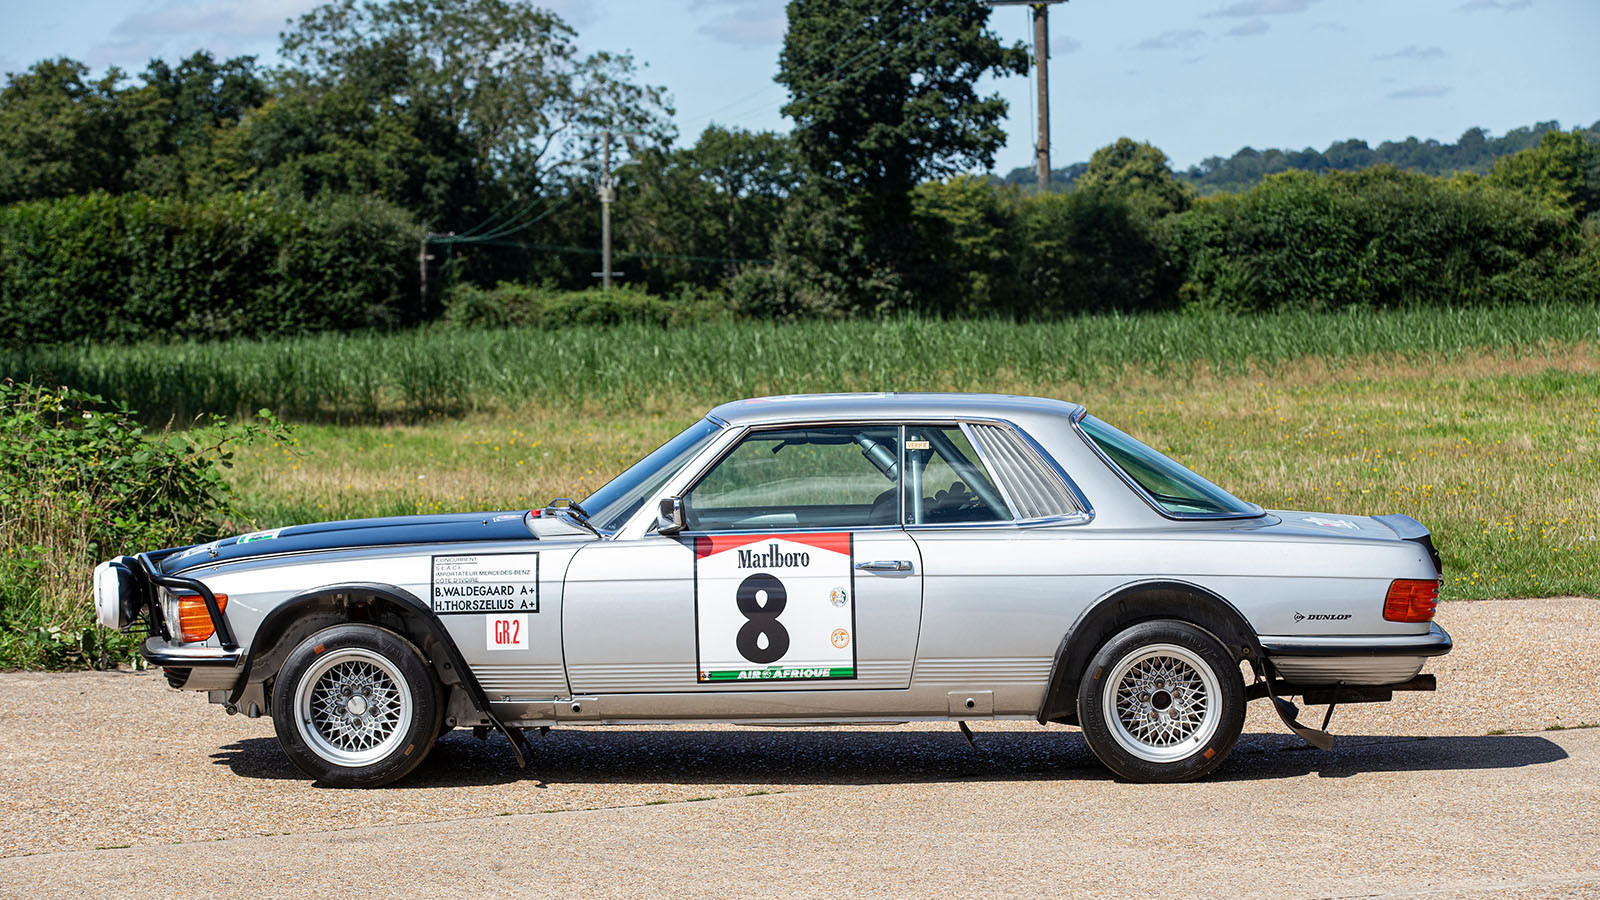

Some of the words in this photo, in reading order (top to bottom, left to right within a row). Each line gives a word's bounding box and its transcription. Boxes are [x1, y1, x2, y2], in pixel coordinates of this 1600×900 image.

[737, 543, 810, 569] Marlboro
[435, 585, 515, 597] B.WALDEGAARD
[520, 585, 535, 595] A+
[435, 599, 514, 611] H.THORSZELIUS
[520, 599, 535, 609] A+
[735, 572, 791, 665] 8
[494, 619, 520, 645] GR.2
[736, 670, 762, 679] AIR
[772, 668, 831, 679] AFRIQUE
